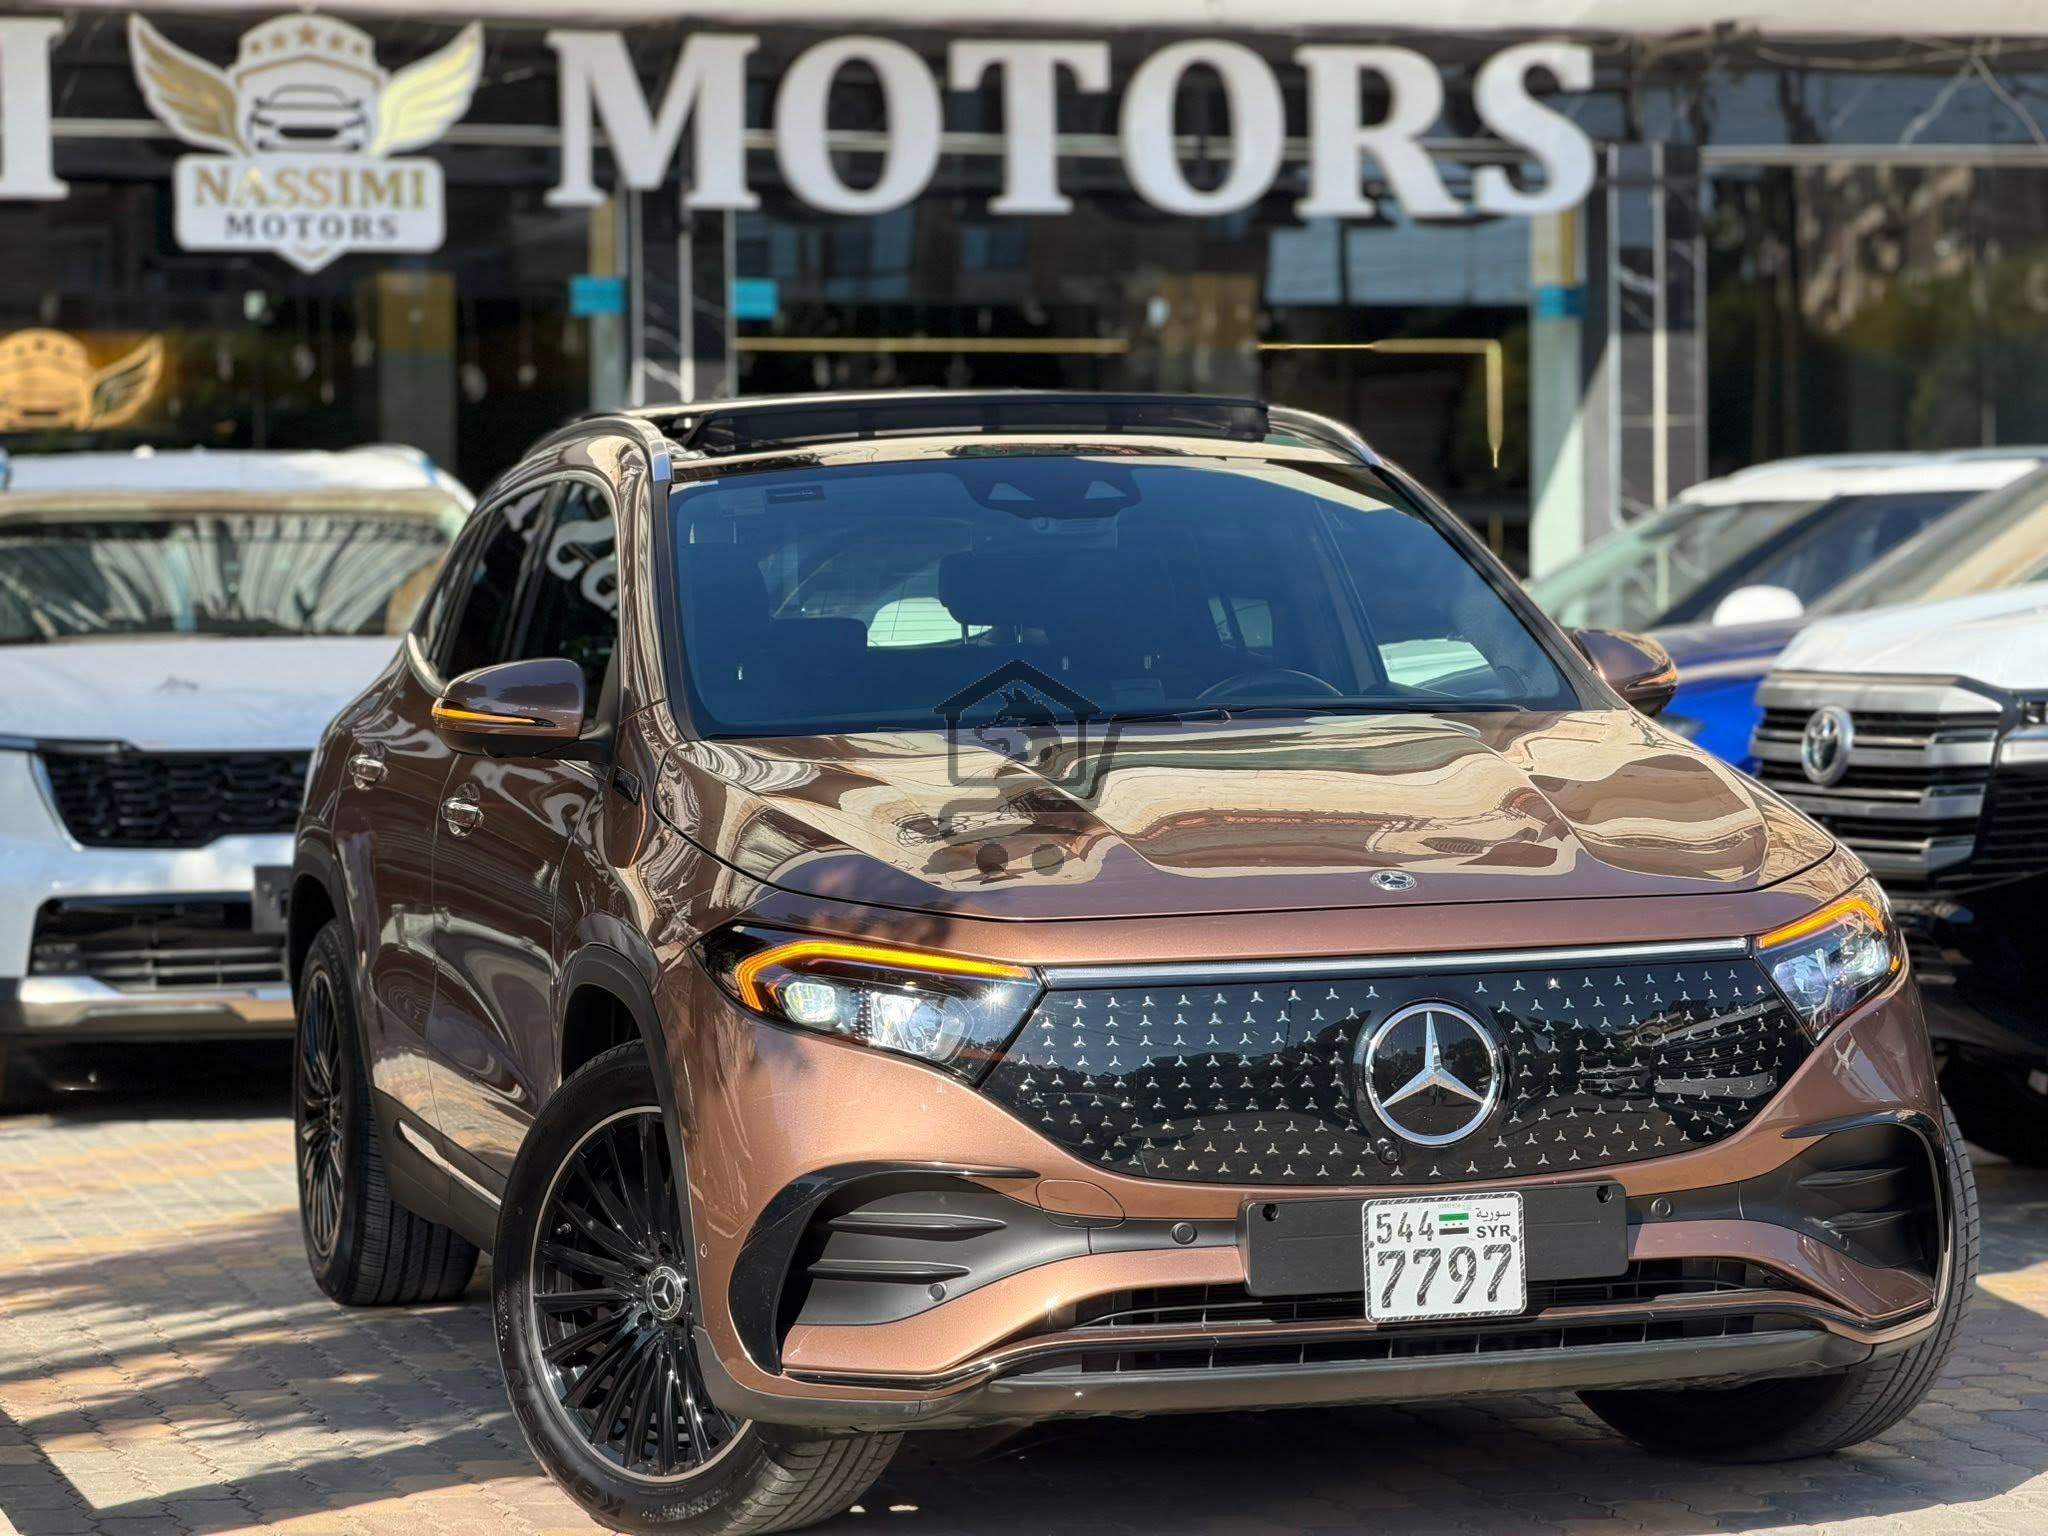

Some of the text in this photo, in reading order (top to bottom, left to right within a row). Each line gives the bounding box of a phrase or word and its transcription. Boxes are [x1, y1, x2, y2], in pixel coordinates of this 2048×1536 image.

[545, 30, 1597, 218] MOTORS
[195, 167, 425, 209] NASSIMI
[225, 213, 398, 241] MOTORS
[1376, 1211, 1511, 1244] 544 SYR
[1475, 1207, 1511, 1222] سورية
[1377, 1244, 1512, 1308] 7797
